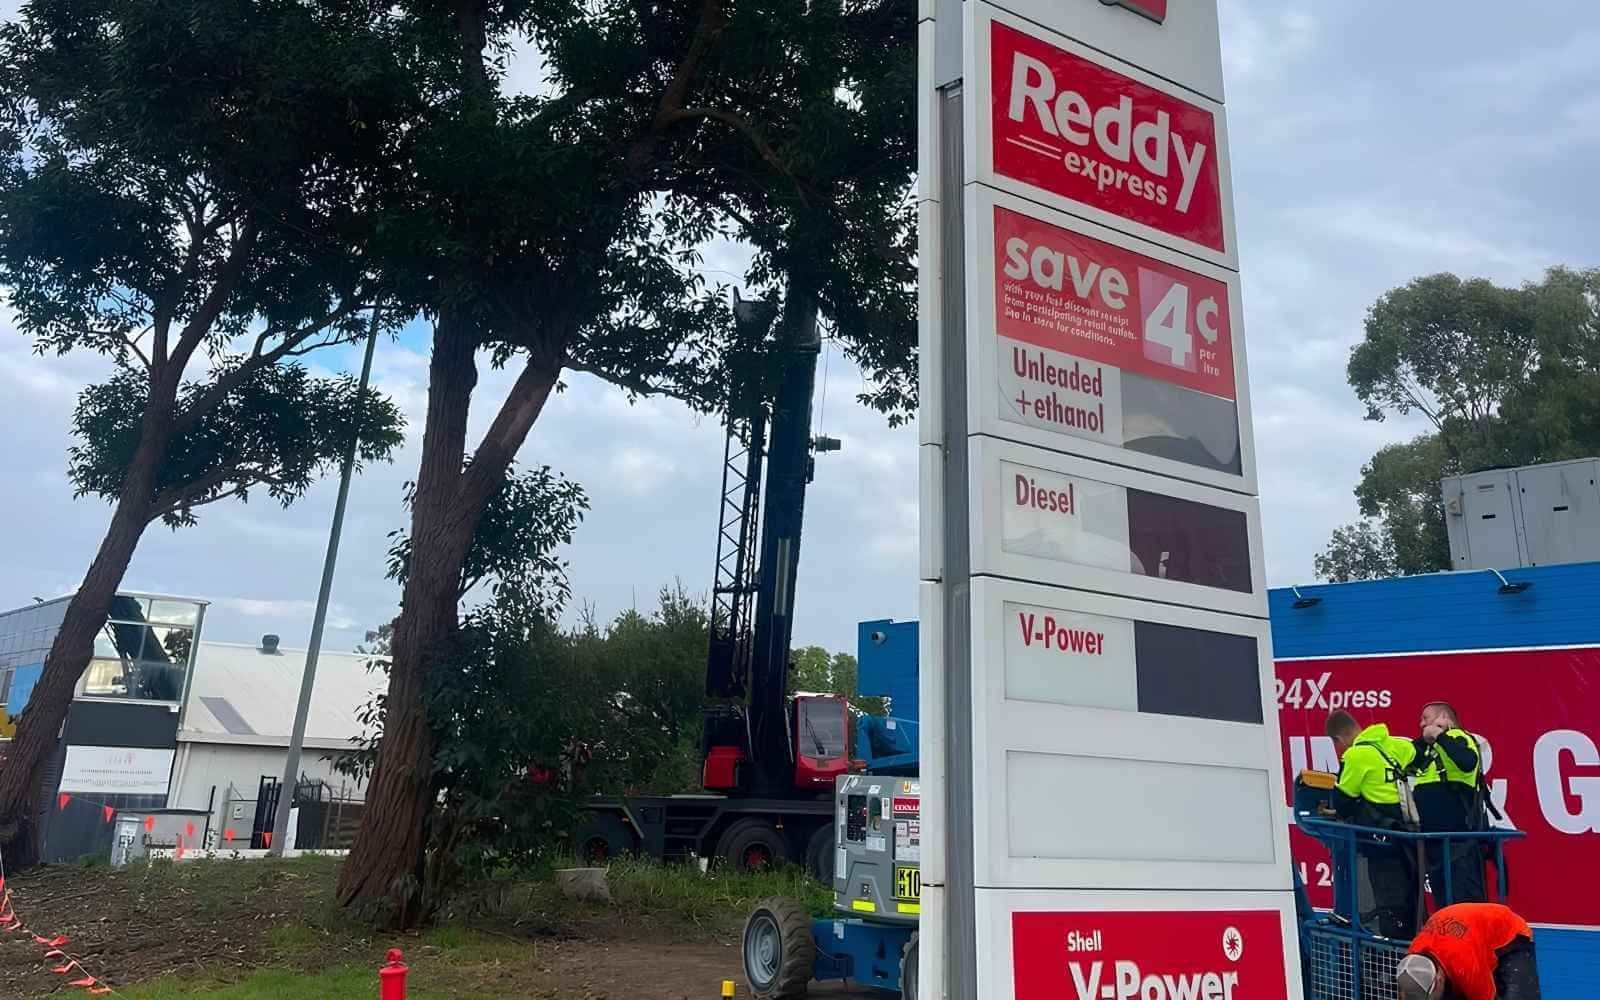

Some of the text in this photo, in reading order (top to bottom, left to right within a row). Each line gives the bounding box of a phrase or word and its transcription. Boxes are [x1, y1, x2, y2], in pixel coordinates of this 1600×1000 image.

[1008, 50, 1206, 214] Reddy
[1064, 151, 1168, 205] express
[1003, 237, 1130, 310] save
[1013, 346, 1103, 398] Unleaded
[1199, 348, 1217, 360] per
[1015, 474, 1075, 516] Diesel
[1018, 612, 1104, 655] V-Power
[1067, 929, 1102, 952] Shell
[1068, 959, 1239, 1000] V-Power
